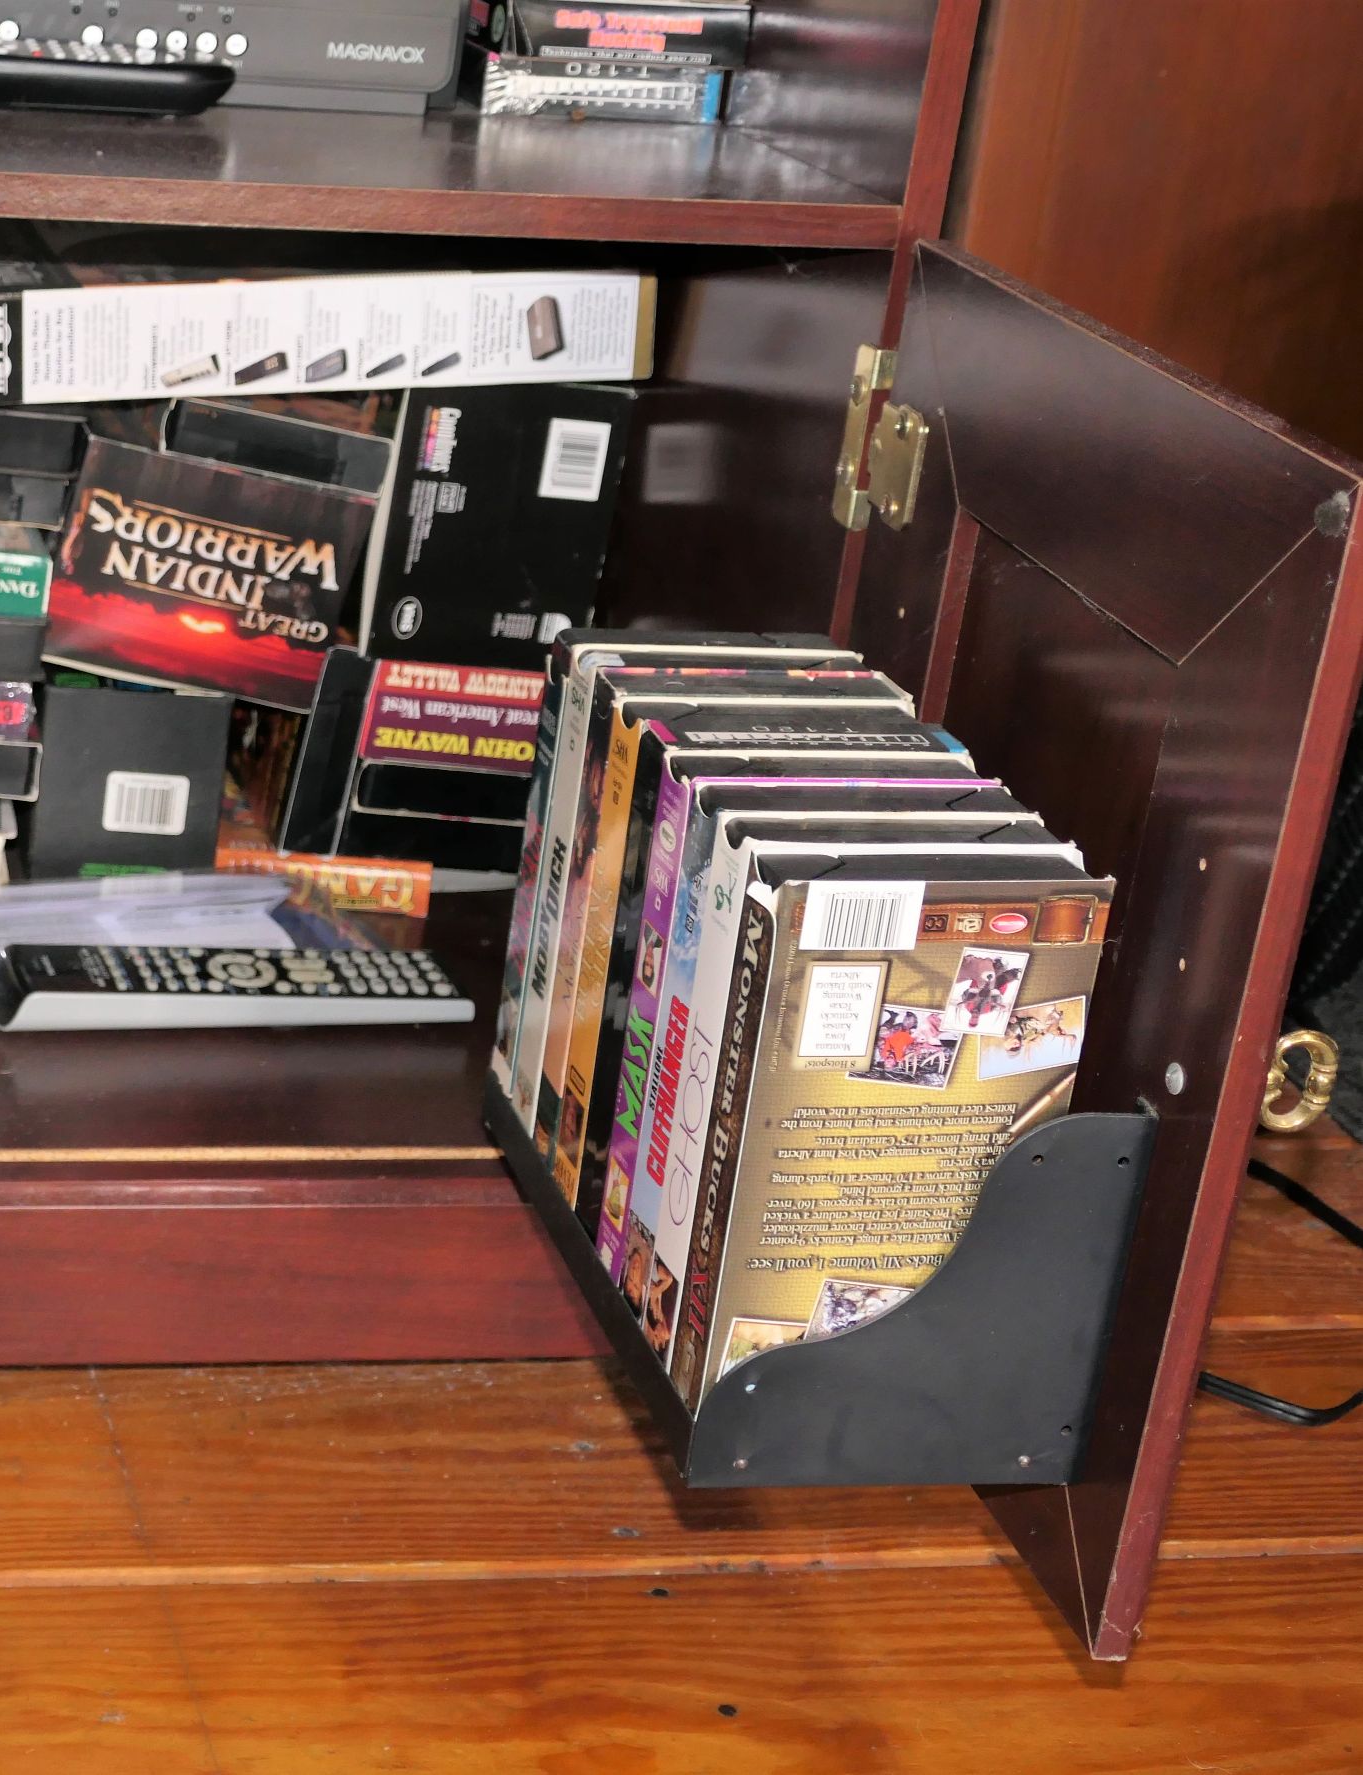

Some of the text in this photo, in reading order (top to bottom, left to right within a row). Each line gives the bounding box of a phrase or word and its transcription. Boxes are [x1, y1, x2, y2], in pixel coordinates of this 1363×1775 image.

[326, 42, 425, 65] MAGNAVOX
[88, 488, 339, 592] WARRIORS
[100, 541, 271, 610] INDIAN
[238, 610, 328, 642] GREAT
[385, 664, 460, 693] VALLEY
[380, 696, 421, 719] West
[424, 701, 504, 726] American
[505, 710, 539, 726] reat
[373, 727, 535, 761] OHN WAYNE
[615, 739, 628, 764] VHS
[653, 867, 669, 896] VHS
[531, 836, 567, 1001] MOBY DICK
[816, 982, 873, 990] South Dakota
[822, 992, 862, 1000] Wyoming
[820, 1012, 859, 1020] Kentucky
[822, 1023, 851, 1031] Kansas
[826, 1033, 846, 1041] Iowa
[816, 1043, 851, 1051] Montana
[804, 1058, 847, 1068] Hotspots!
[616, 1004, 655, 1139] MASK
[648, 1045, 663, 1111] STALLONE
[646, 995, 691, 1188] CLIFFHANGER
[794, 1104, 1016, 1118] hottest deer hunting destinations the world!
[669, 1011, 714, 1226] GHOST
[781, 1115, 1013, 1130] Fourteen more bowhunts and gun hunts from the
[689, 909, 764, 1341] MONSTER BUCKS XII
[847, 1132, 1010, 1146] and bring home Canadian
[778, 1147, 957, 1159] Brewers manager Ned Yost hunt Alberta
[772, 1173, 804, 1185] during
[806, 1173, 831, 1184] yards
[833, 1174, 845, 1183] 10
[857, 1174, 891, 1183] bruiser
[925, 1172, 952, 1180] arrow
[867, 1185, 902, 1196] ground
[913, 1185, 936, 1194] from
[938, 1183, 962, 1193] buck
[819, 1198, 864, 1207] gorgeous
[875, 1198, 894, 1207] take
[910, 1196, 963, 1205] snowstorm
[763, 1213, 801, 1222] wicked
[812, 1212, 848, 1220] endure
[851, 1212, 880, 1220] Drake
[883, 1210, 899, 1219] Joe
[900, 1210, 931, 1219] Staffer
[933, 1209, 950, 1217] Pro
[831, 1224, 864, 1232] Encore
[867, 1219, 953, 1231] Thompson/Center
[759, 1235, 806, 1245] 9-pointer
[810, 1236, 854, 1245] Kentucky
[857, 1233, 881, 1245] huge
[891, 1234, 911, 1243] take
[914, 1233, 951, 1242] Waddell
[746, 1258, 773, 1270] see:
[829, 1258, 877, 1269] Volume
